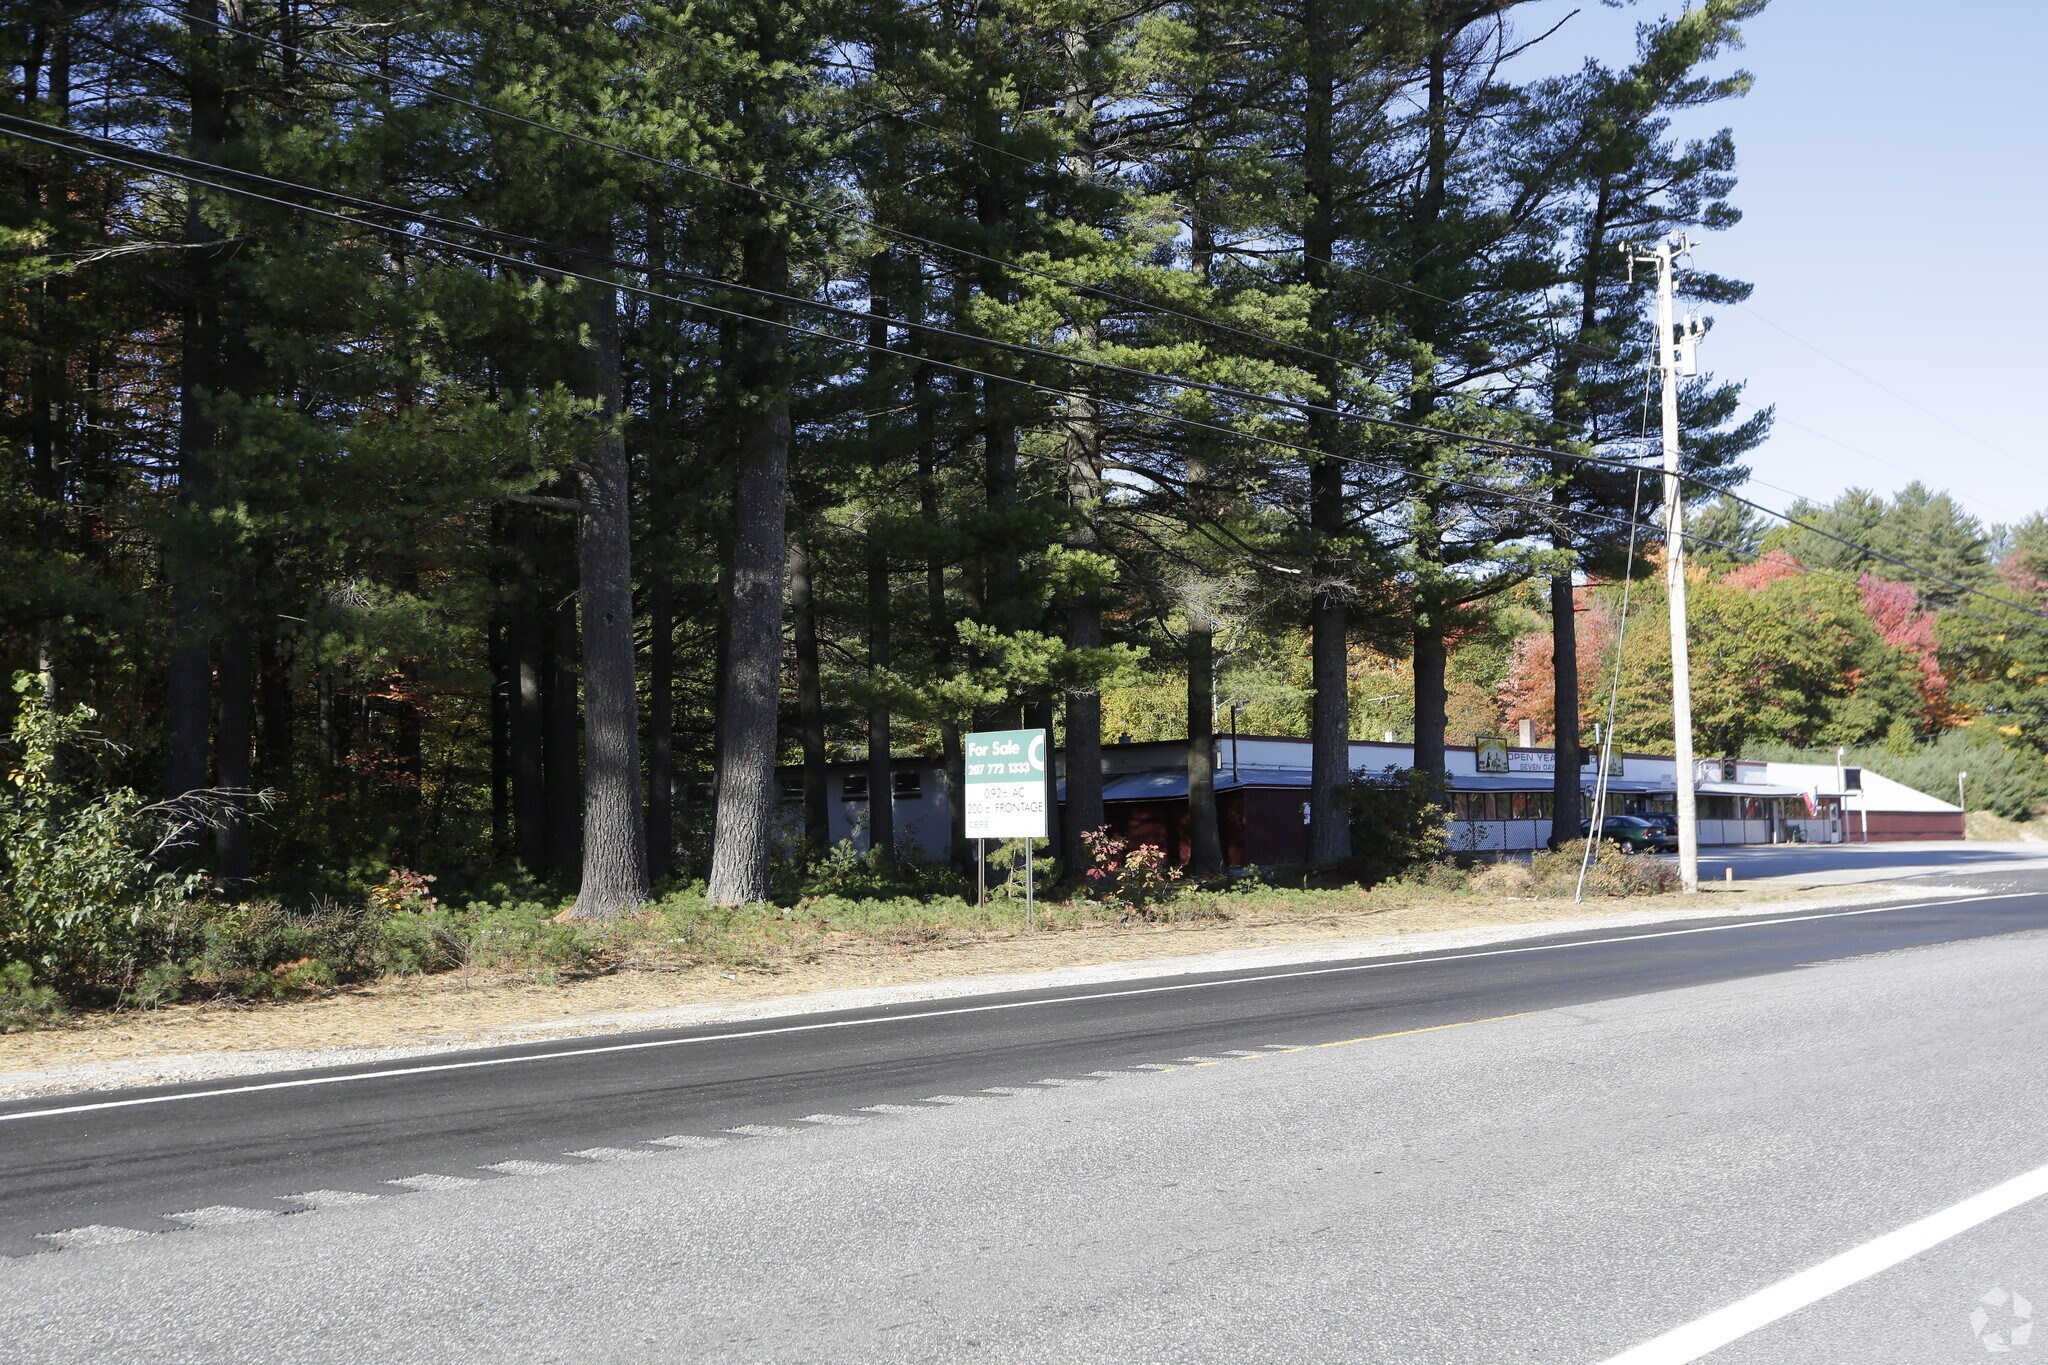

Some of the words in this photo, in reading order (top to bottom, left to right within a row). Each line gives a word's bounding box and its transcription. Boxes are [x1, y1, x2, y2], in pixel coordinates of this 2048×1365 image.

[968, 743, 989, 757] For
[992, 740, 1020, 756] Sale
[1508, 753, 1533, 761] OPEN
[1536, 753, 1555, 762] YEA
[968, 764, 985, 775] 207
[987, 763, 1004, 774] 772
[1519, 763, 1541, 771] SEVEN
[1543, 763, 1555, 771] DAY
[1012, 787, 1024, 798] AC
[995, 801, 1043, 813] FRONTAGE
